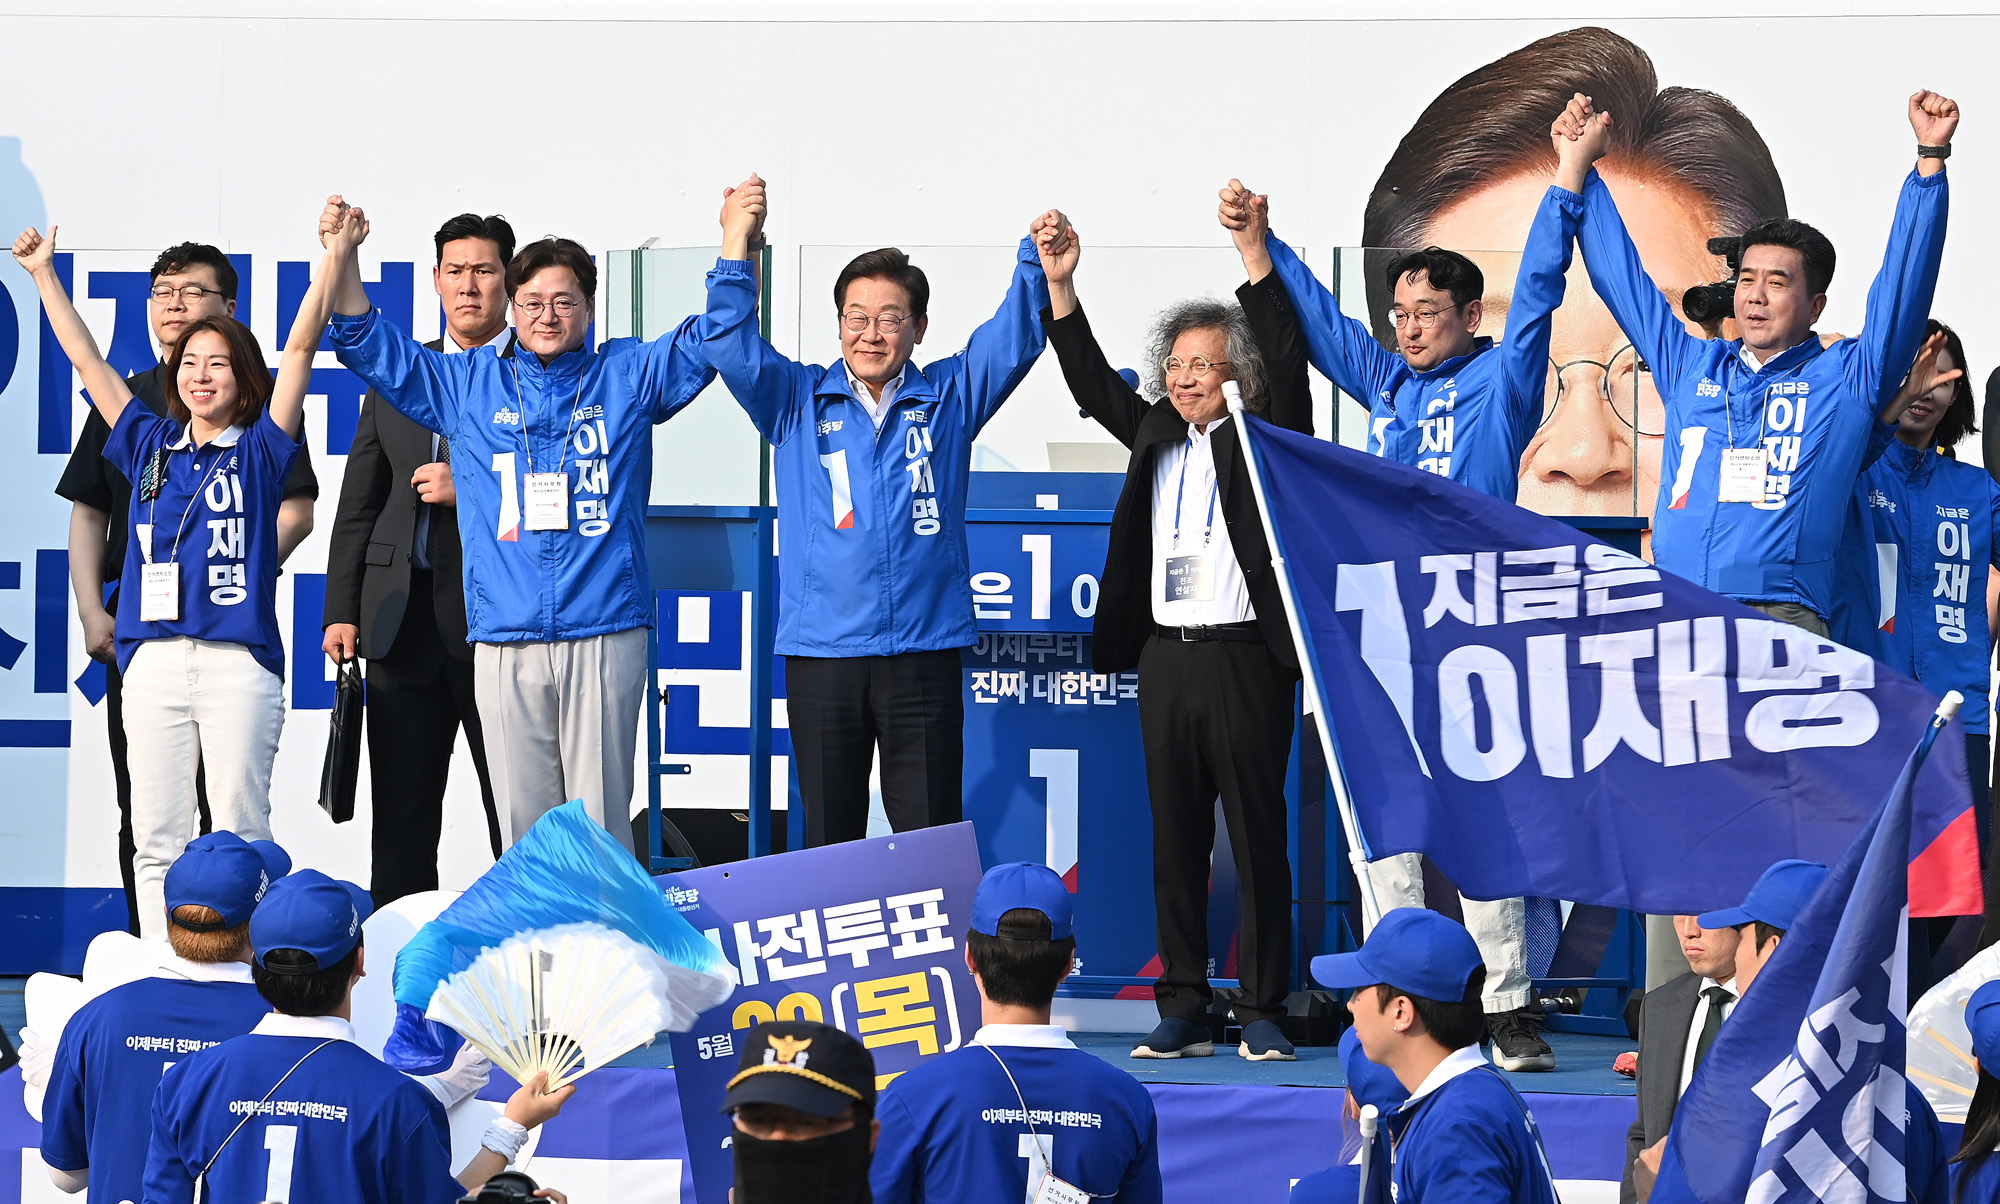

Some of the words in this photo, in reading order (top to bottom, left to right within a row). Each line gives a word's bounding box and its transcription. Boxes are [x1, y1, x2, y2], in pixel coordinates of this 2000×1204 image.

[493, 411, 520, 425] 민주당
[573, 405, 604, 422] 지금은
[1770, 382, 1810, 395] 지금은
[573, 420, 611, 537] 이재명
[820, 449, 854, 530] 1
[905, 427, 940, 535] 이재명
[1667, 426, 1709, 510] 1
[1751, 397, 1807, 511] 이재명
[492, 452, 521, 542] 1
[1936, 505, 1970, 520] 지금은
[204, 474, 248, 606] 이재명
[1021, 534, 1052, 620] 1
[1419, 543, 1664, 629] 지금은
[1933, 521, 1971, 644] 이재명
[970, 670, 1029, 704] 진짜
[972, 634, 1082, 664] 이제부터
[1336, 560, 1433, 780] 1
[1438, 617, 1881, 782] 이재명
[1029, 749, 1079, 893] 1
[703, 888, 956, 987] 사전투표
[126, 1036, 174, 1053] 이제부터
[176, 1038, 202, 1053] 진짜
[697, 1033, 734, 1060] 5월
[229, 1100, 274, 1116] 이제부터
[275, 1101, 299, 1116] 진짜
[299, 1101, 348, 1122] 대한민국
[981, 1108, 1027, 1124] 이제부터
[1028, 1110, 1053, 1126] 진짜
[1054, 1111, 1103, 1128] 대한민국
[264, 1125, 298, 1204] 1
[1018, 1133, 1054, 1204] 1
